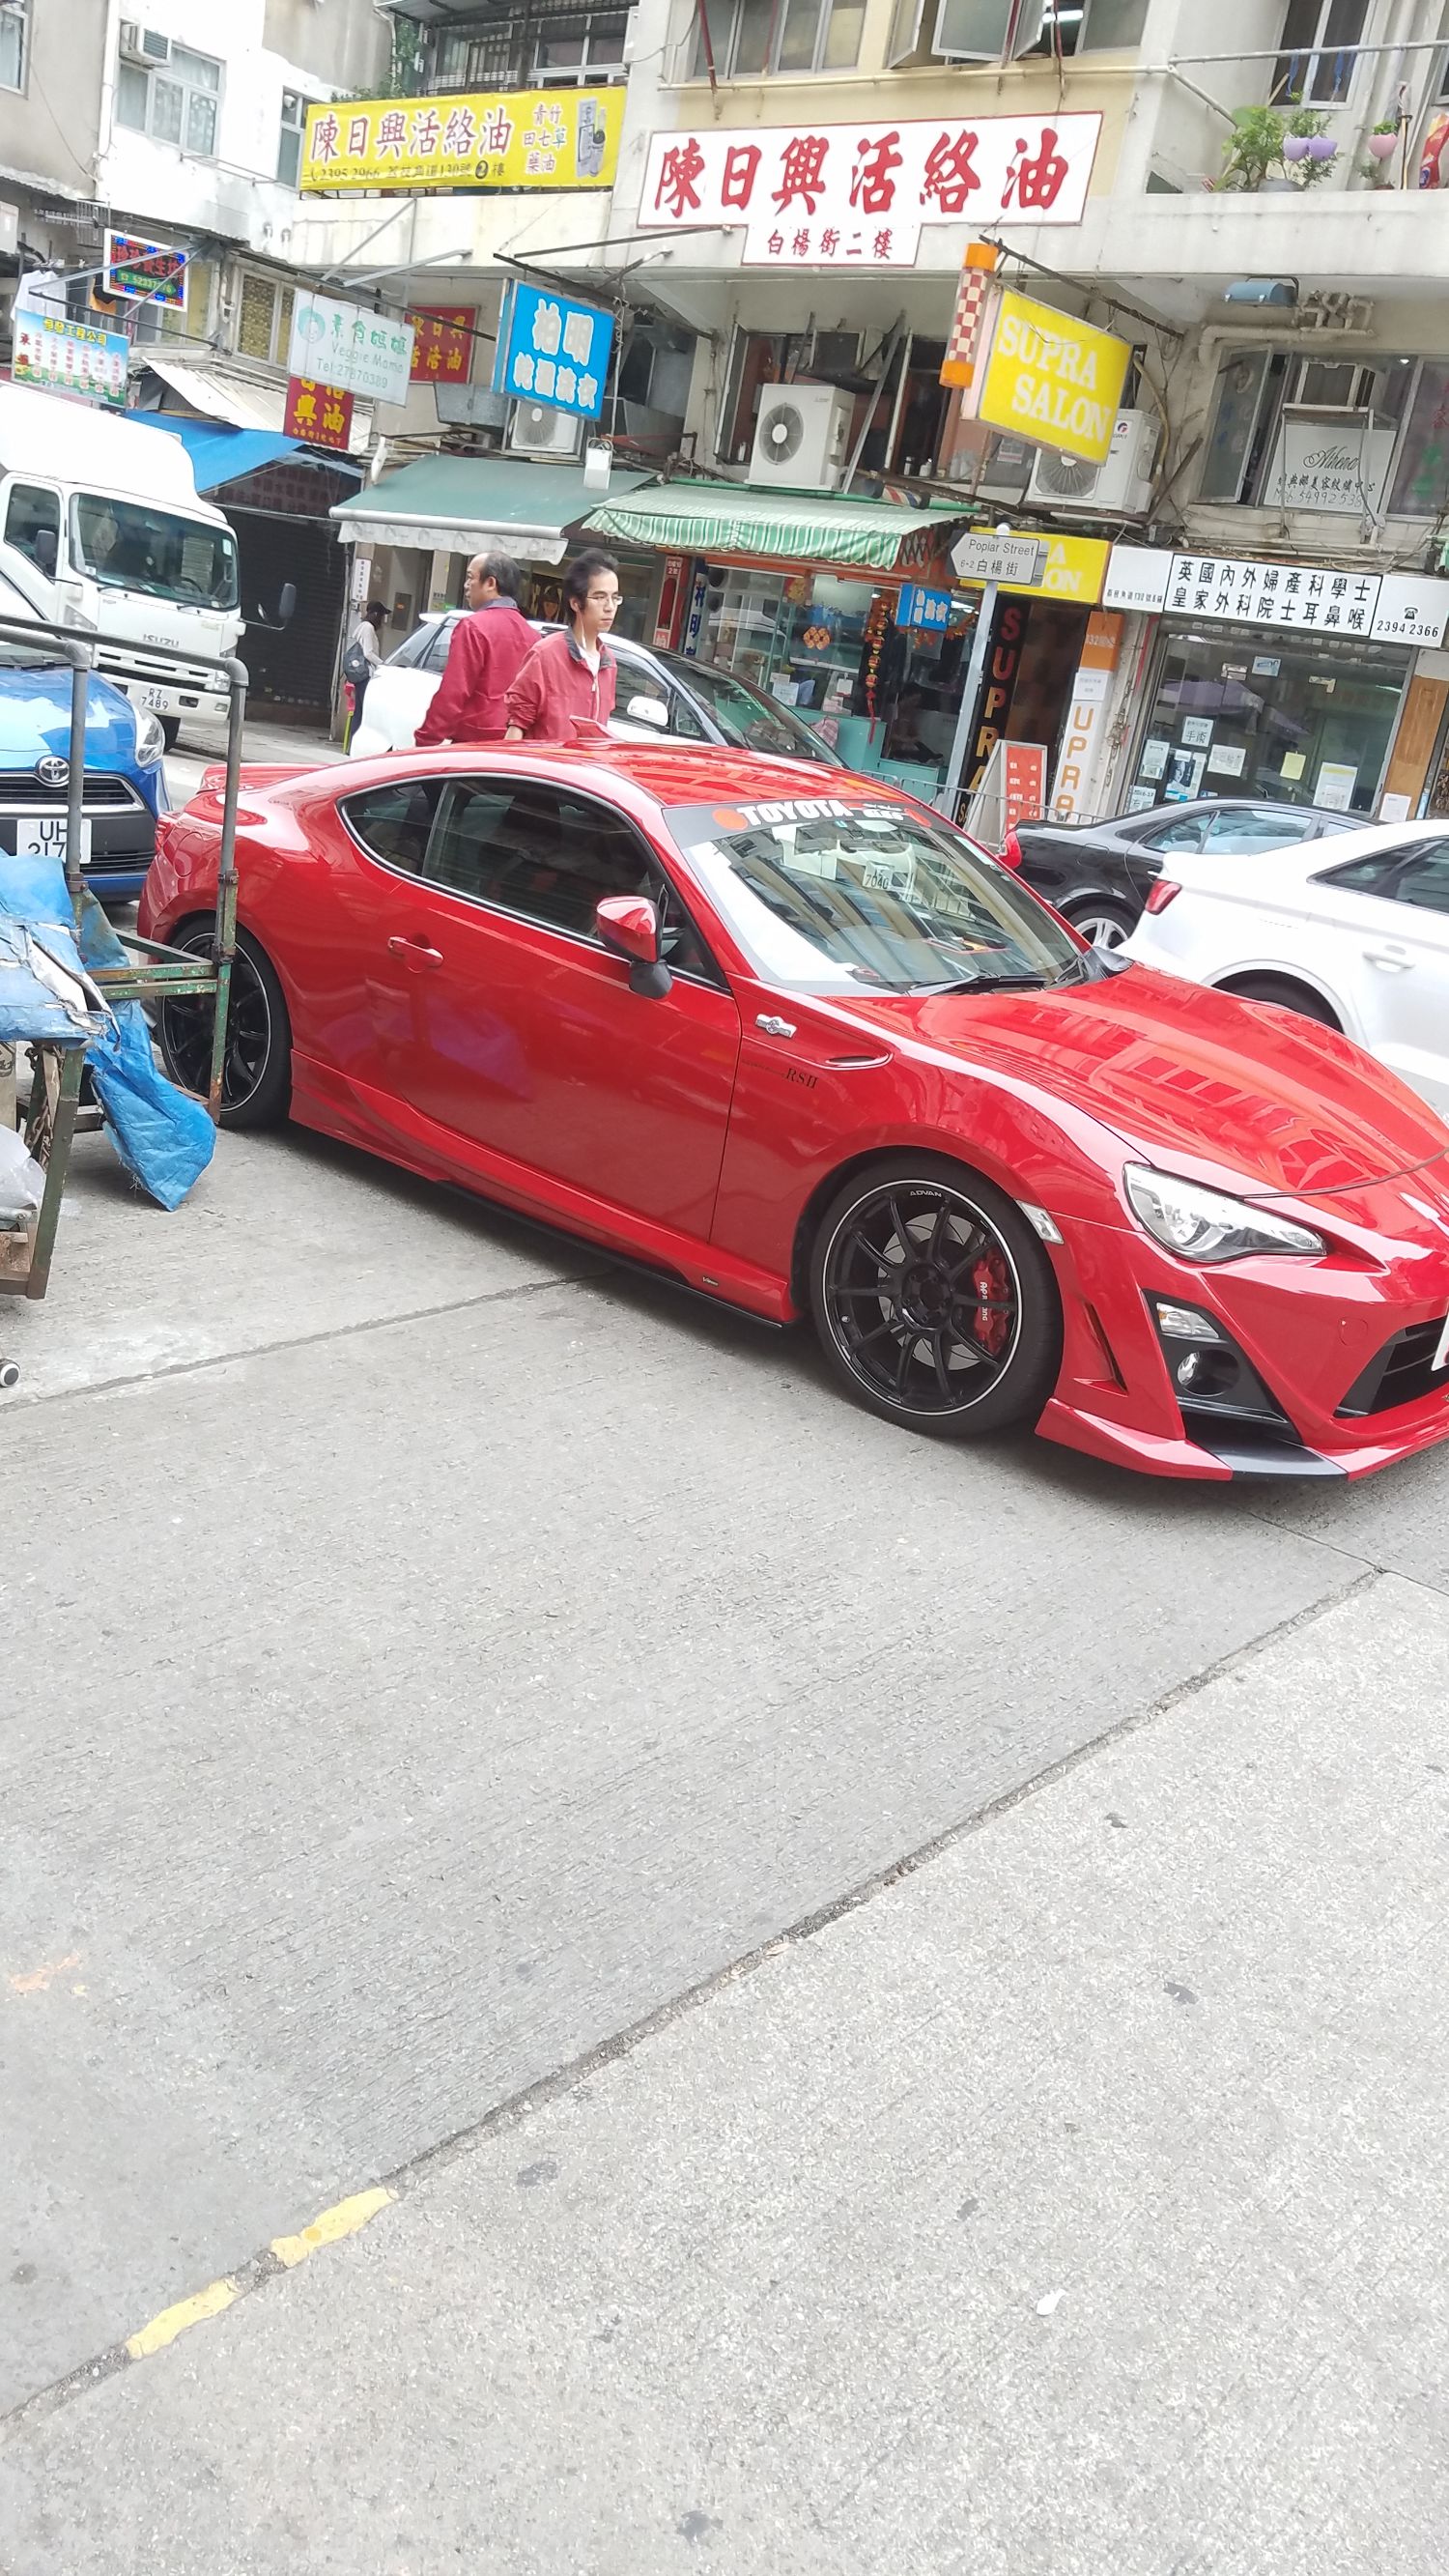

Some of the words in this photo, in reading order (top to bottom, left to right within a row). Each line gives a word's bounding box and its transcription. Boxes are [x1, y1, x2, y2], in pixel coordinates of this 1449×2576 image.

[532, 102, 562, 125] 青竹
[310, 105, 513, 162] 陳日興活絡油
[523, 127, 567, 149] 田七草
[654, 127, 1069, 218] 陳日興活絡油
[767, 228, 894, 260] 白楊街二樓
[331, 313, 408, 355] 素食媽媽
[532, 298, 594, 366] 柏明
[331, 340, 369, 364] Veggie
[373, 354, 404, 374] Mama
[997, 314, 1098, 391] SUPRA
[1011, 373, 1113, 444] SALON
[960, 558, 975, 569] 6-2
[969, 538, 1000, 554] Poplar
[1003, 542, 1035, 557] Street
[977, 558, 1019, 576] 白楊街
[1179, 560, 1371, 602] 英國內外婦產科學士
[1172, 587, 1365, 631] 皇家外科院士耳鼻喉
[1377, 619, 1406, 634] 2394
[1409, 623, 1439, 638] 2366
[141, 697, 169, 709] 7489
[149, 687, 163, 699] RZ
[969, 607, 1021, 795] SUPRA
[737, 799, 854, 826] TOYOTA
[910, 1189, 942, 1198] ADVAN
